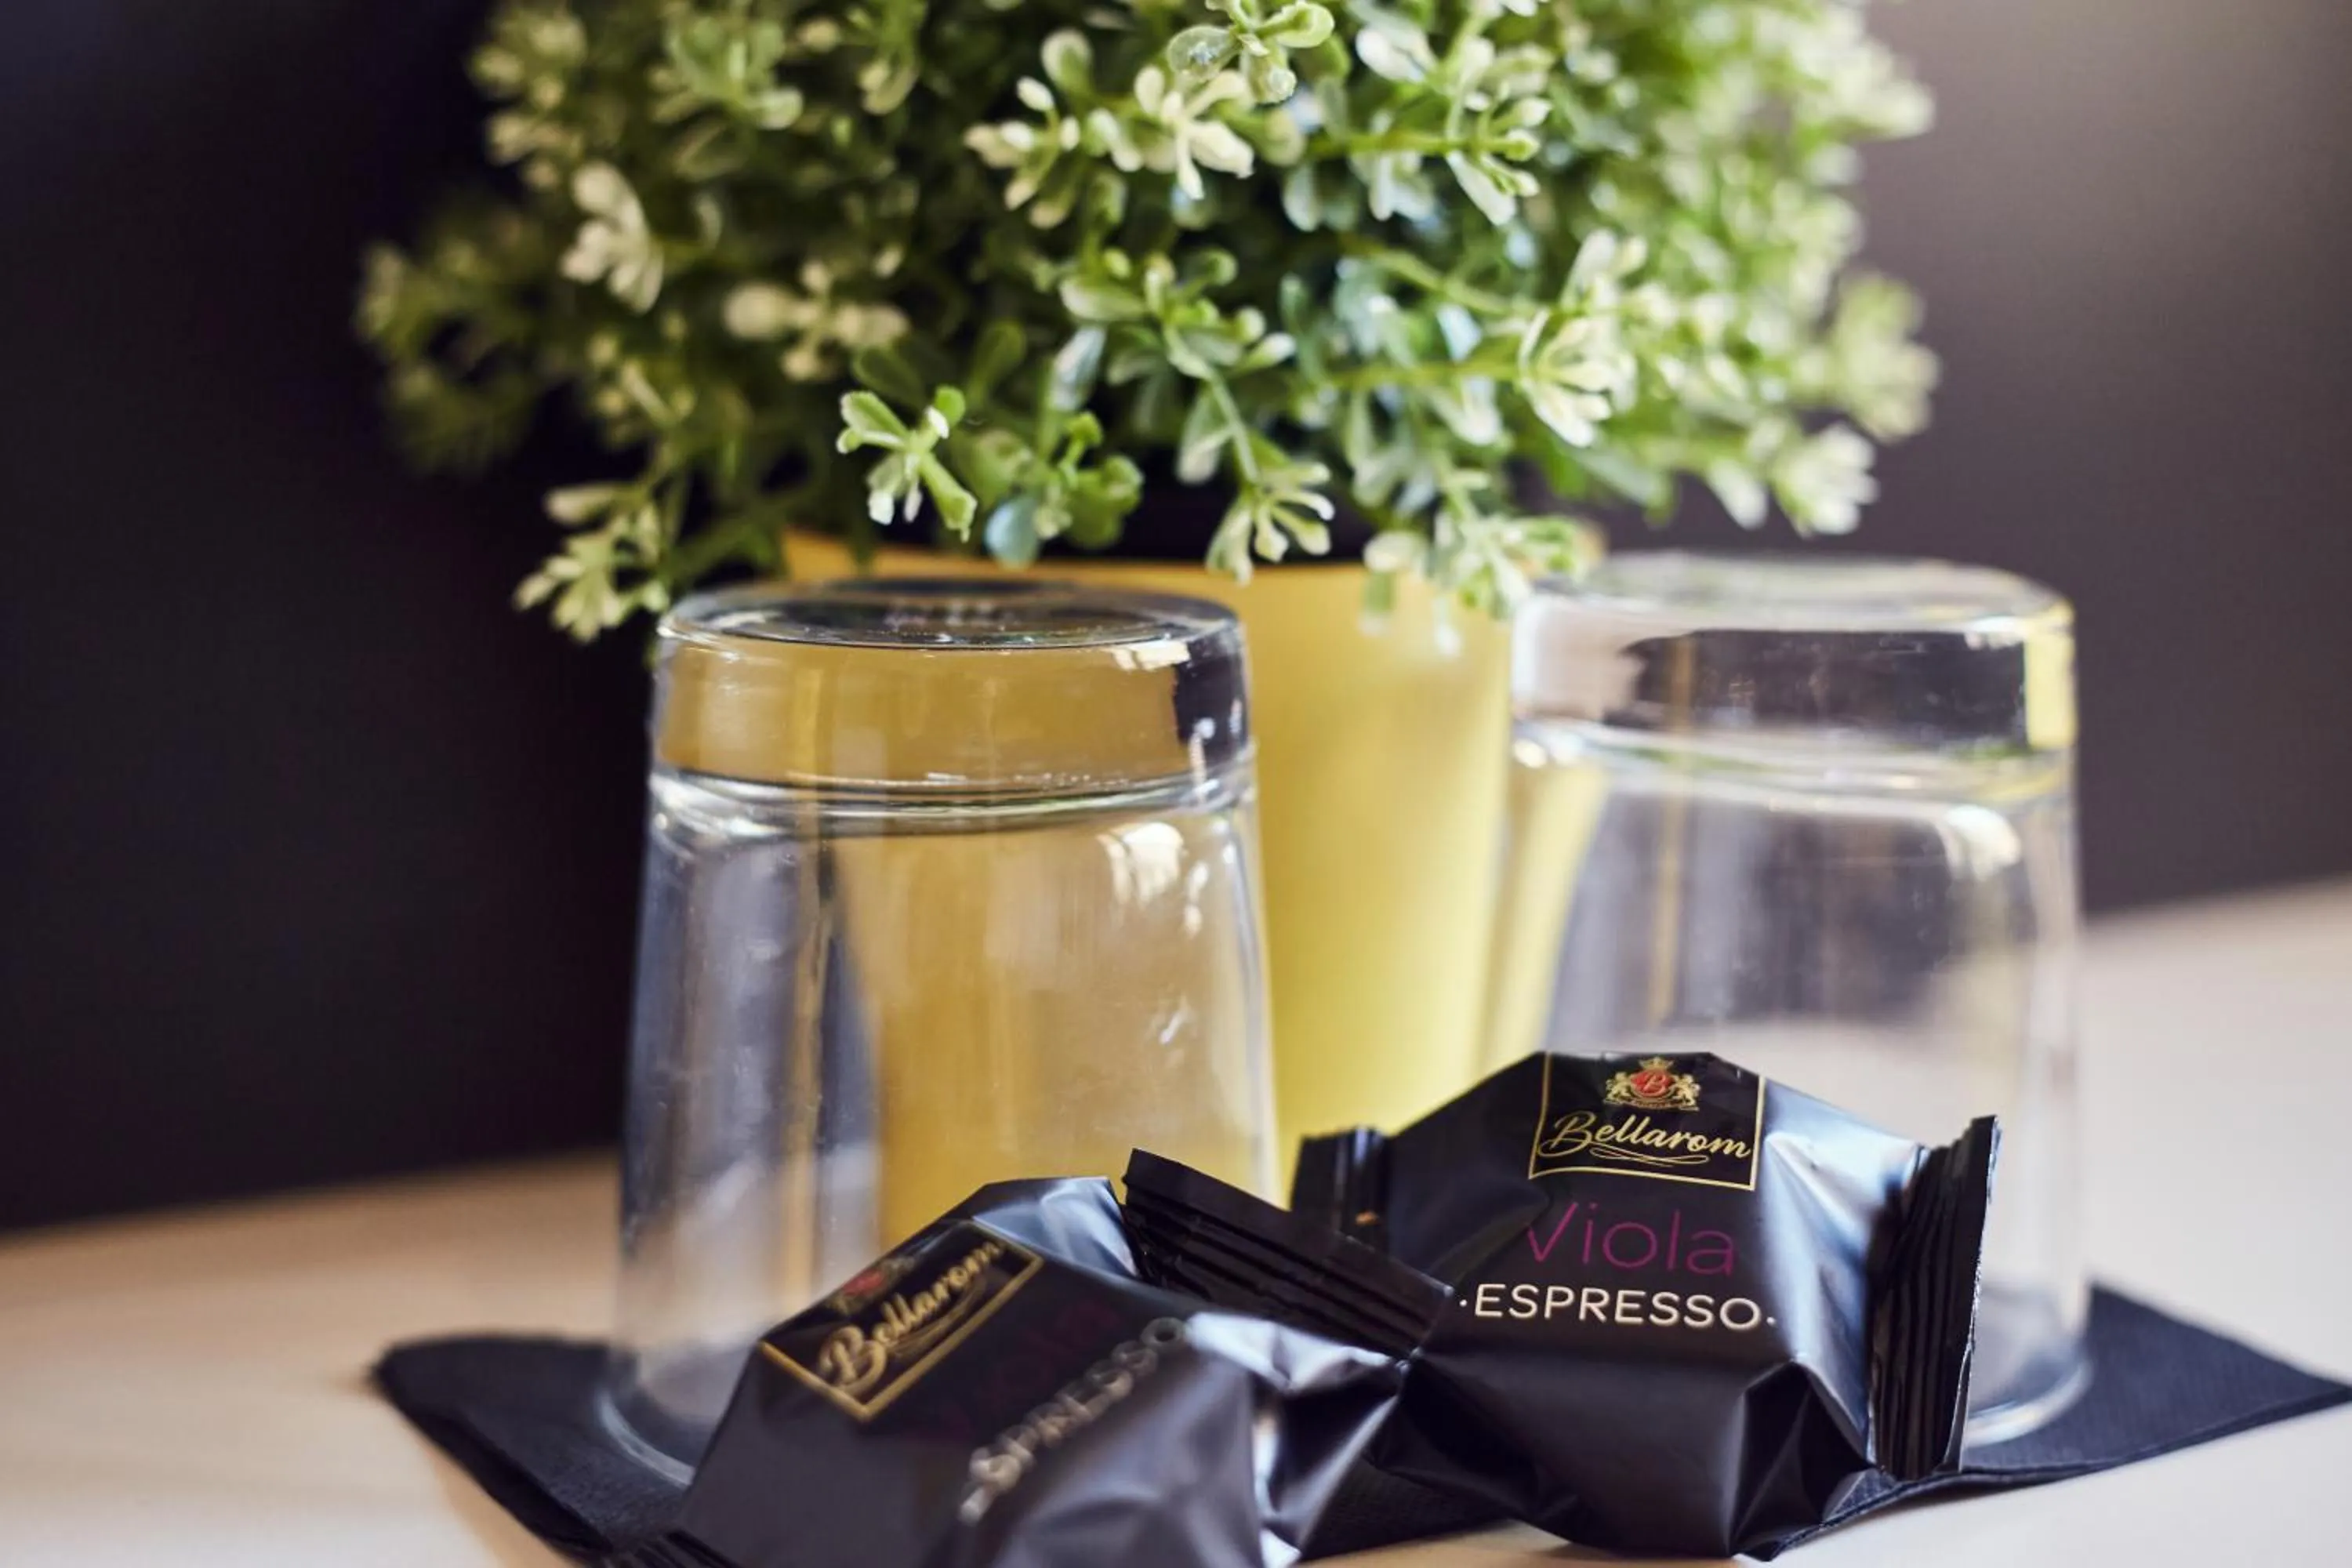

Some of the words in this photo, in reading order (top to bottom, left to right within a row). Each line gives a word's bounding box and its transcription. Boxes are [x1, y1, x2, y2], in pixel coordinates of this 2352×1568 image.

[1537, 1110, 1751, 1159] Bellarom
[1527, 1201, 1737, 1276] Viola
[820, 1241, 1005, 1396] Bellarom
